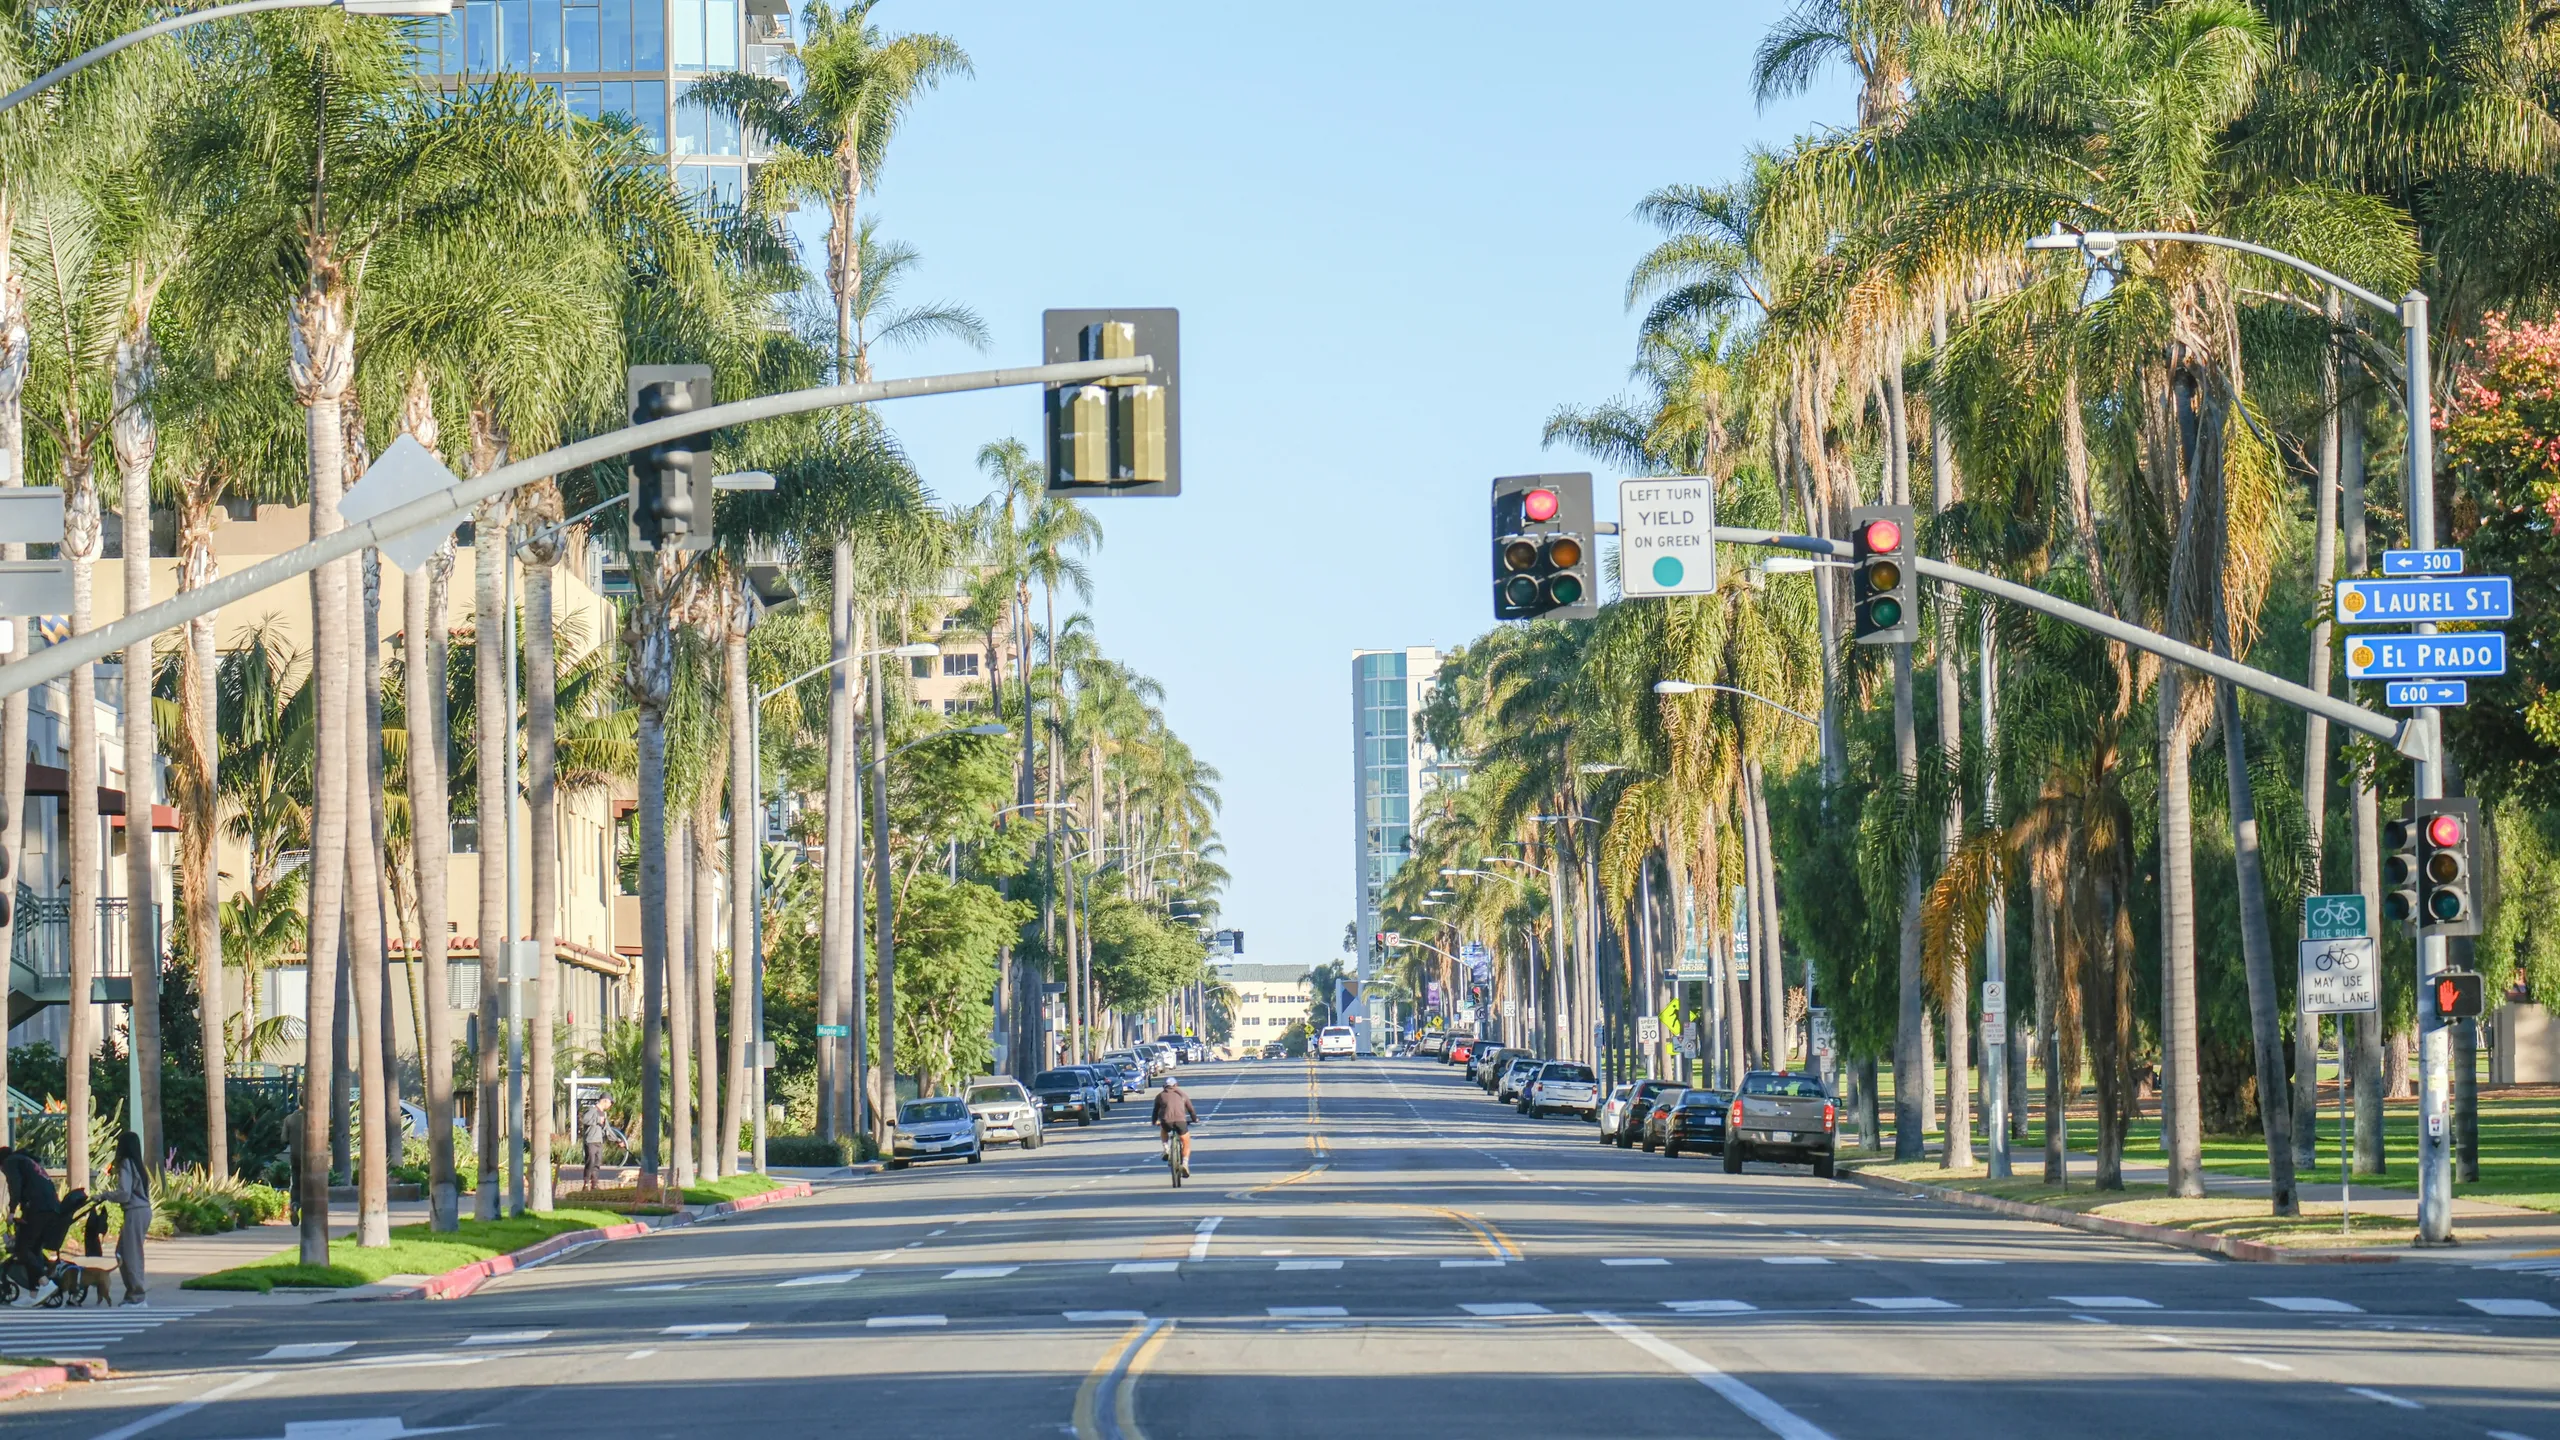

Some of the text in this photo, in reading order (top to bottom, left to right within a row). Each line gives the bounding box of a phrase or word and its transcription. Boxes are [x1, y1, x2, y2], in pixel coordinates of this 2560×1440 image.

[1629, 487, 1702, 501] LEFT TURN
[1638, 510, 1694, 526] YIELD
[1635, 535, 1700, 548] ON GREEN
[2423, 554, 2451, 570] 500
[2373, 590, 2454, 613] LAUREL
[2382, 644, 2492, 668] EL PRADO
[2400, 686, 2428, 702] 600
[2312, 928, 2362, 938] BIKE ROUTE
[2314, 975, 2363, 988] MAY USE
[2308, 991, 2370, 1004] FULL LANE
[818, 1025, 837, 1036] Maple
[1641, 1030, 1657, 1040] 30
